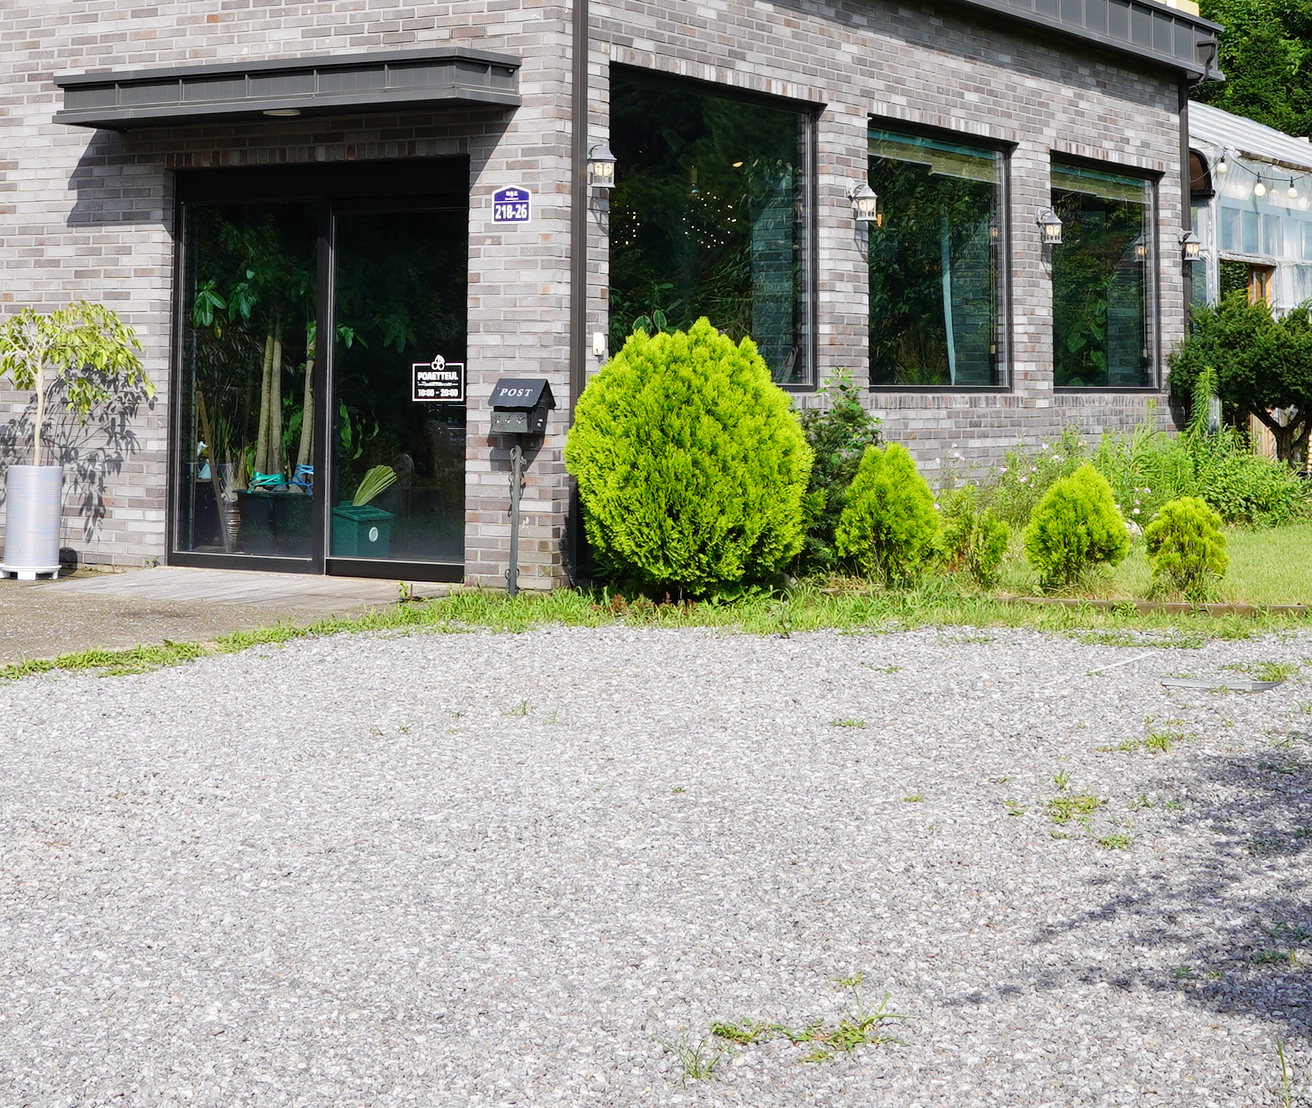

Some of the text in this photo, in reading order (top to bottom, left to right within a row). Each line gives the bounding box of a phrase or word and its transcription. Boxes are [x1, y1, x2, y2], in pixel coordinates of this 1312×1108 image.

[495, 204, 527, 219] 218-26
[417, 371, 459, 381] POAETTEUL
[499, 388, 533, 397] POST
